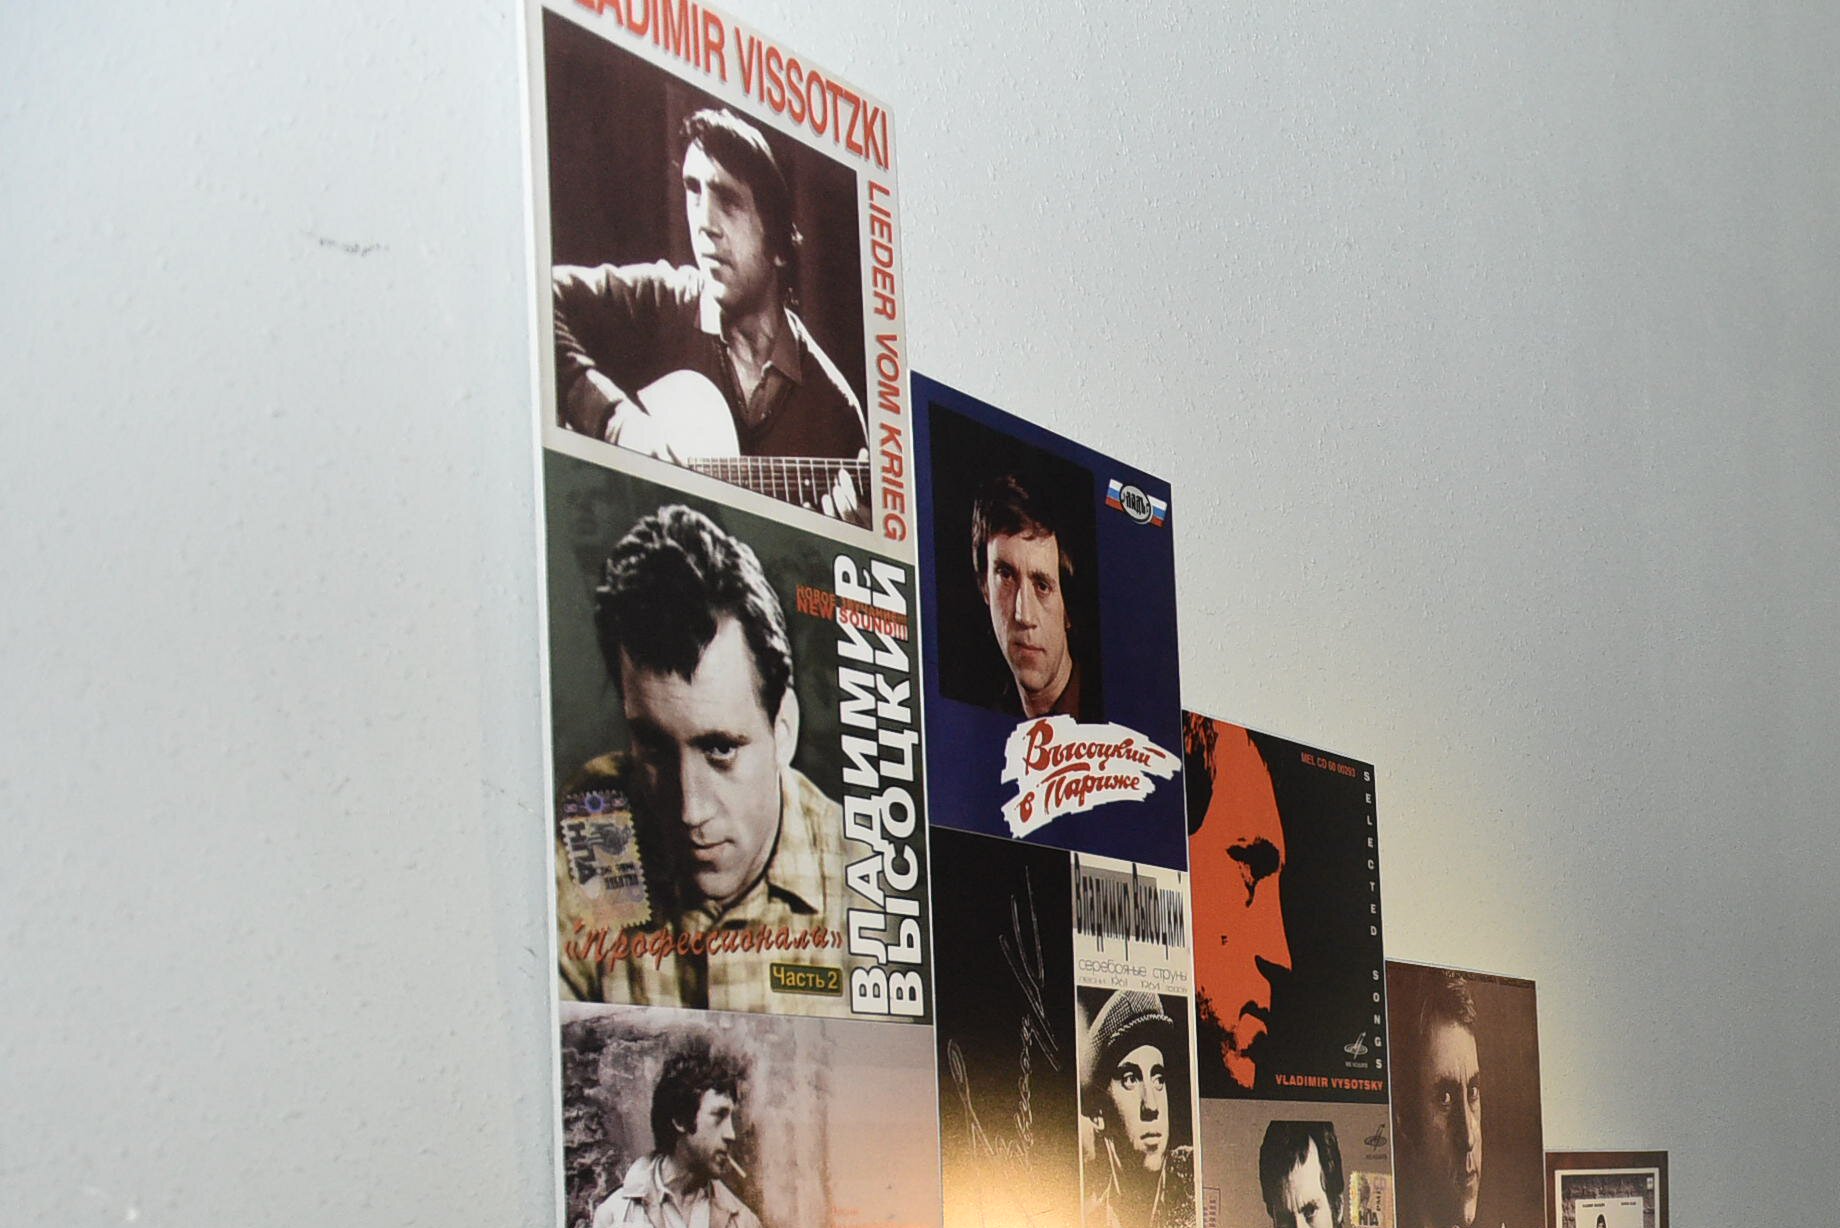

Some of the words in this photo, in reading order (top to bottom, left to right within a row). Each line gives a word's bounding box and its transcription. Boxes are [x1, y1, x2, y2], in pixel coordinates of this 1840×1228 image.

[574, 0, 728, 83] DIMIR
[735, 26, 890, 171] VISSOTZKI
[867, 179, 899, 322] LIEDER
[876, 333, 903, 410] VOM
[879, 422, 908, 543] KRIEG
[833, 553, 889, 1016] ВЛАДИМИР
[864, 555, 926, 1018] ВЫСОЦКИЙ
[1023, 717, 1165, 778] Высоцкий
[1040, 761, 1141, 810] Париже
[772, 963, 824, 990] Часть
[826, 969, 840, 990] 2
[1275, 1074, 1329, 1089] VLADIMIR
[1331, 1077, 1384, 1091] VYSOTSKY
